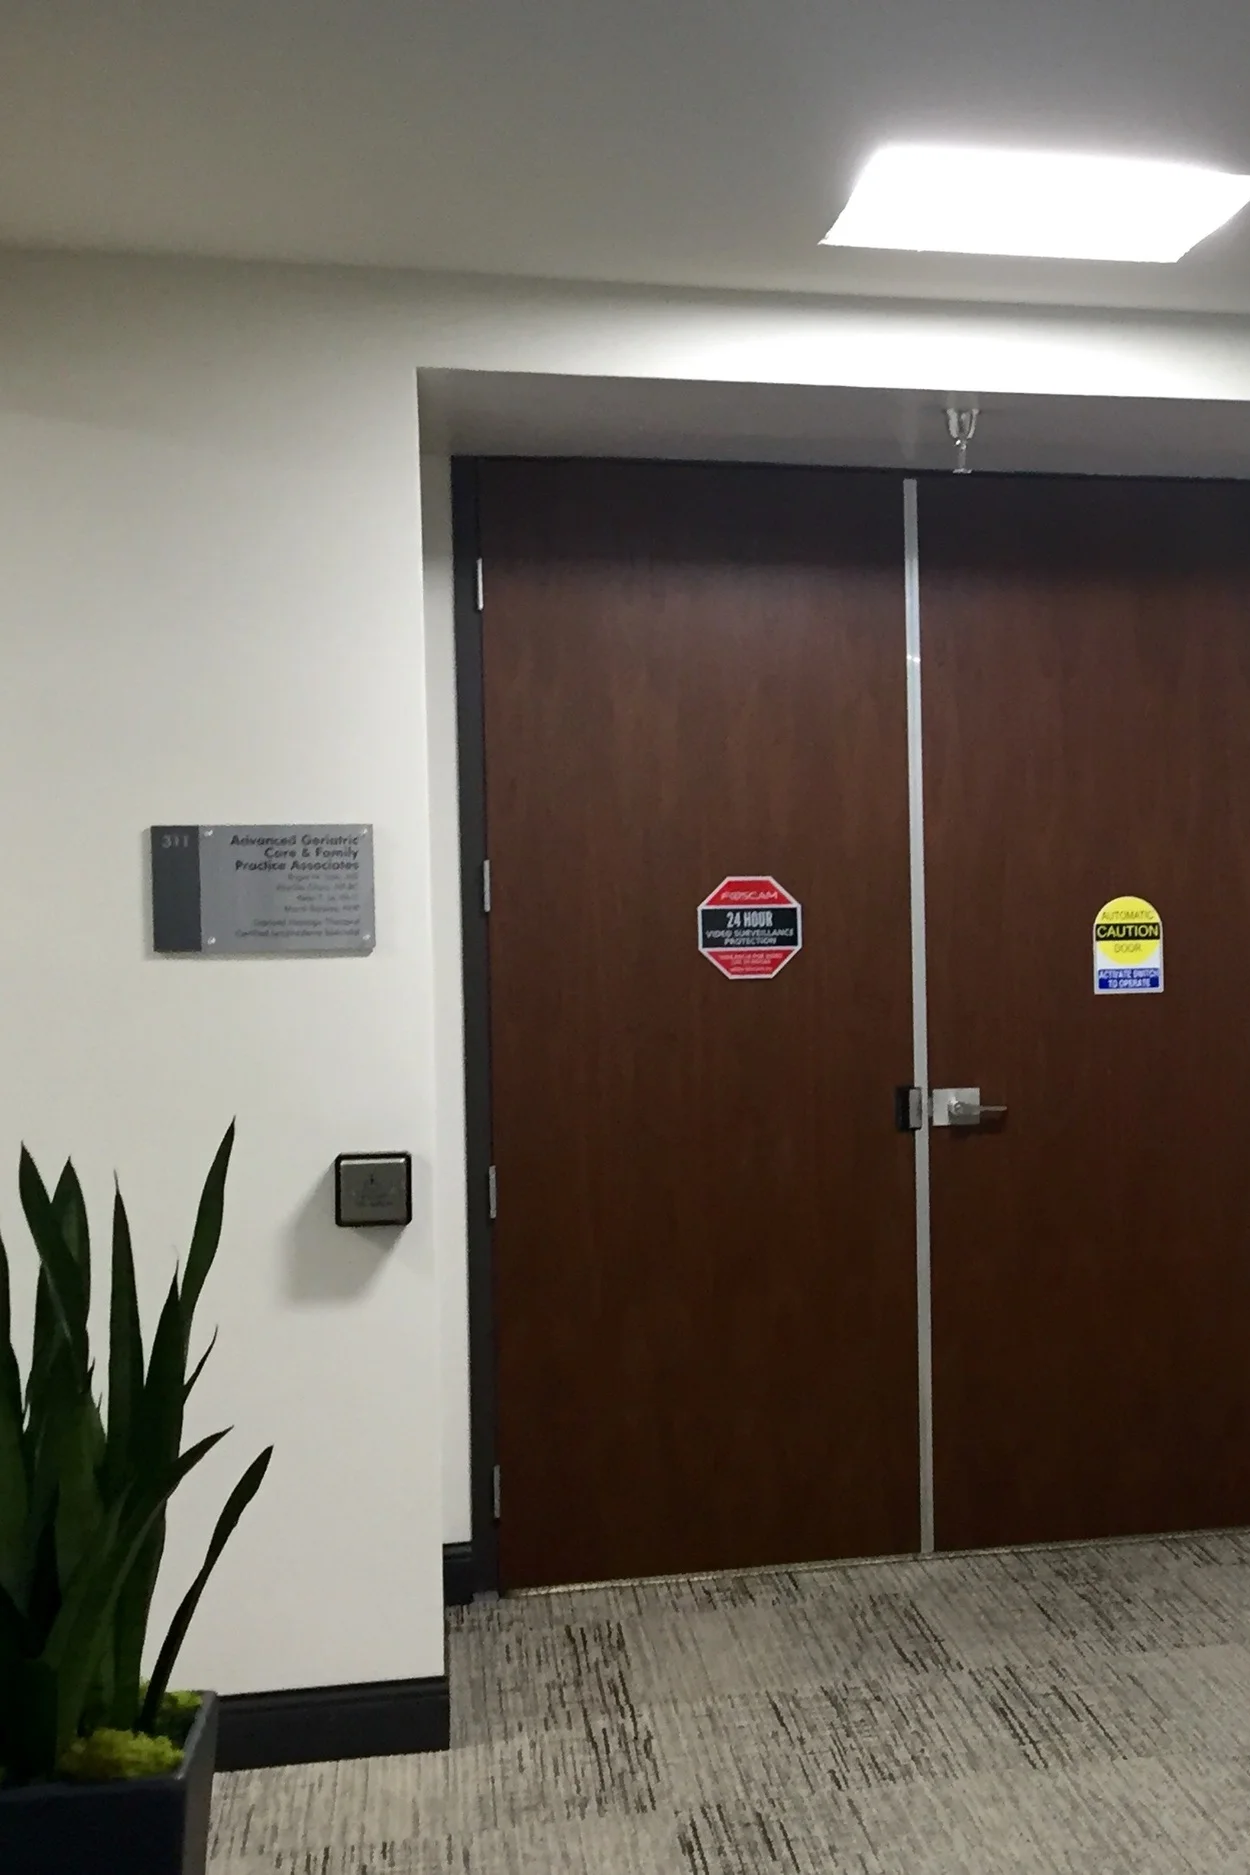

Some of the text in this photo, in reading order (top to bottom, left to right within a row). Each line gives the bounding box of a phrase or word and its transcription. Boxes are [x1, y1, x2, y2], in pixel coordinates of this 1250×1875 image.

[230, 834, 359, 846] Advanced Geriatric
[264, 846, 359, 860] Care & Family
[235, 859, 359, 871] Practice Associates
[726, 910, 773, 928] 24 HOUR
[1101, 910, 1154, 921] AUTOMATIC
[705, 928, 794, 939] VIDEO SURVEILLANCE
[1096, 925, 1159, 939] CAUTION
[724, 938, 777, 946] PROTECTION
[1114, 943, 1142, 953] DOOR
[1107, 979, 1151, 988] TO OPERATE
